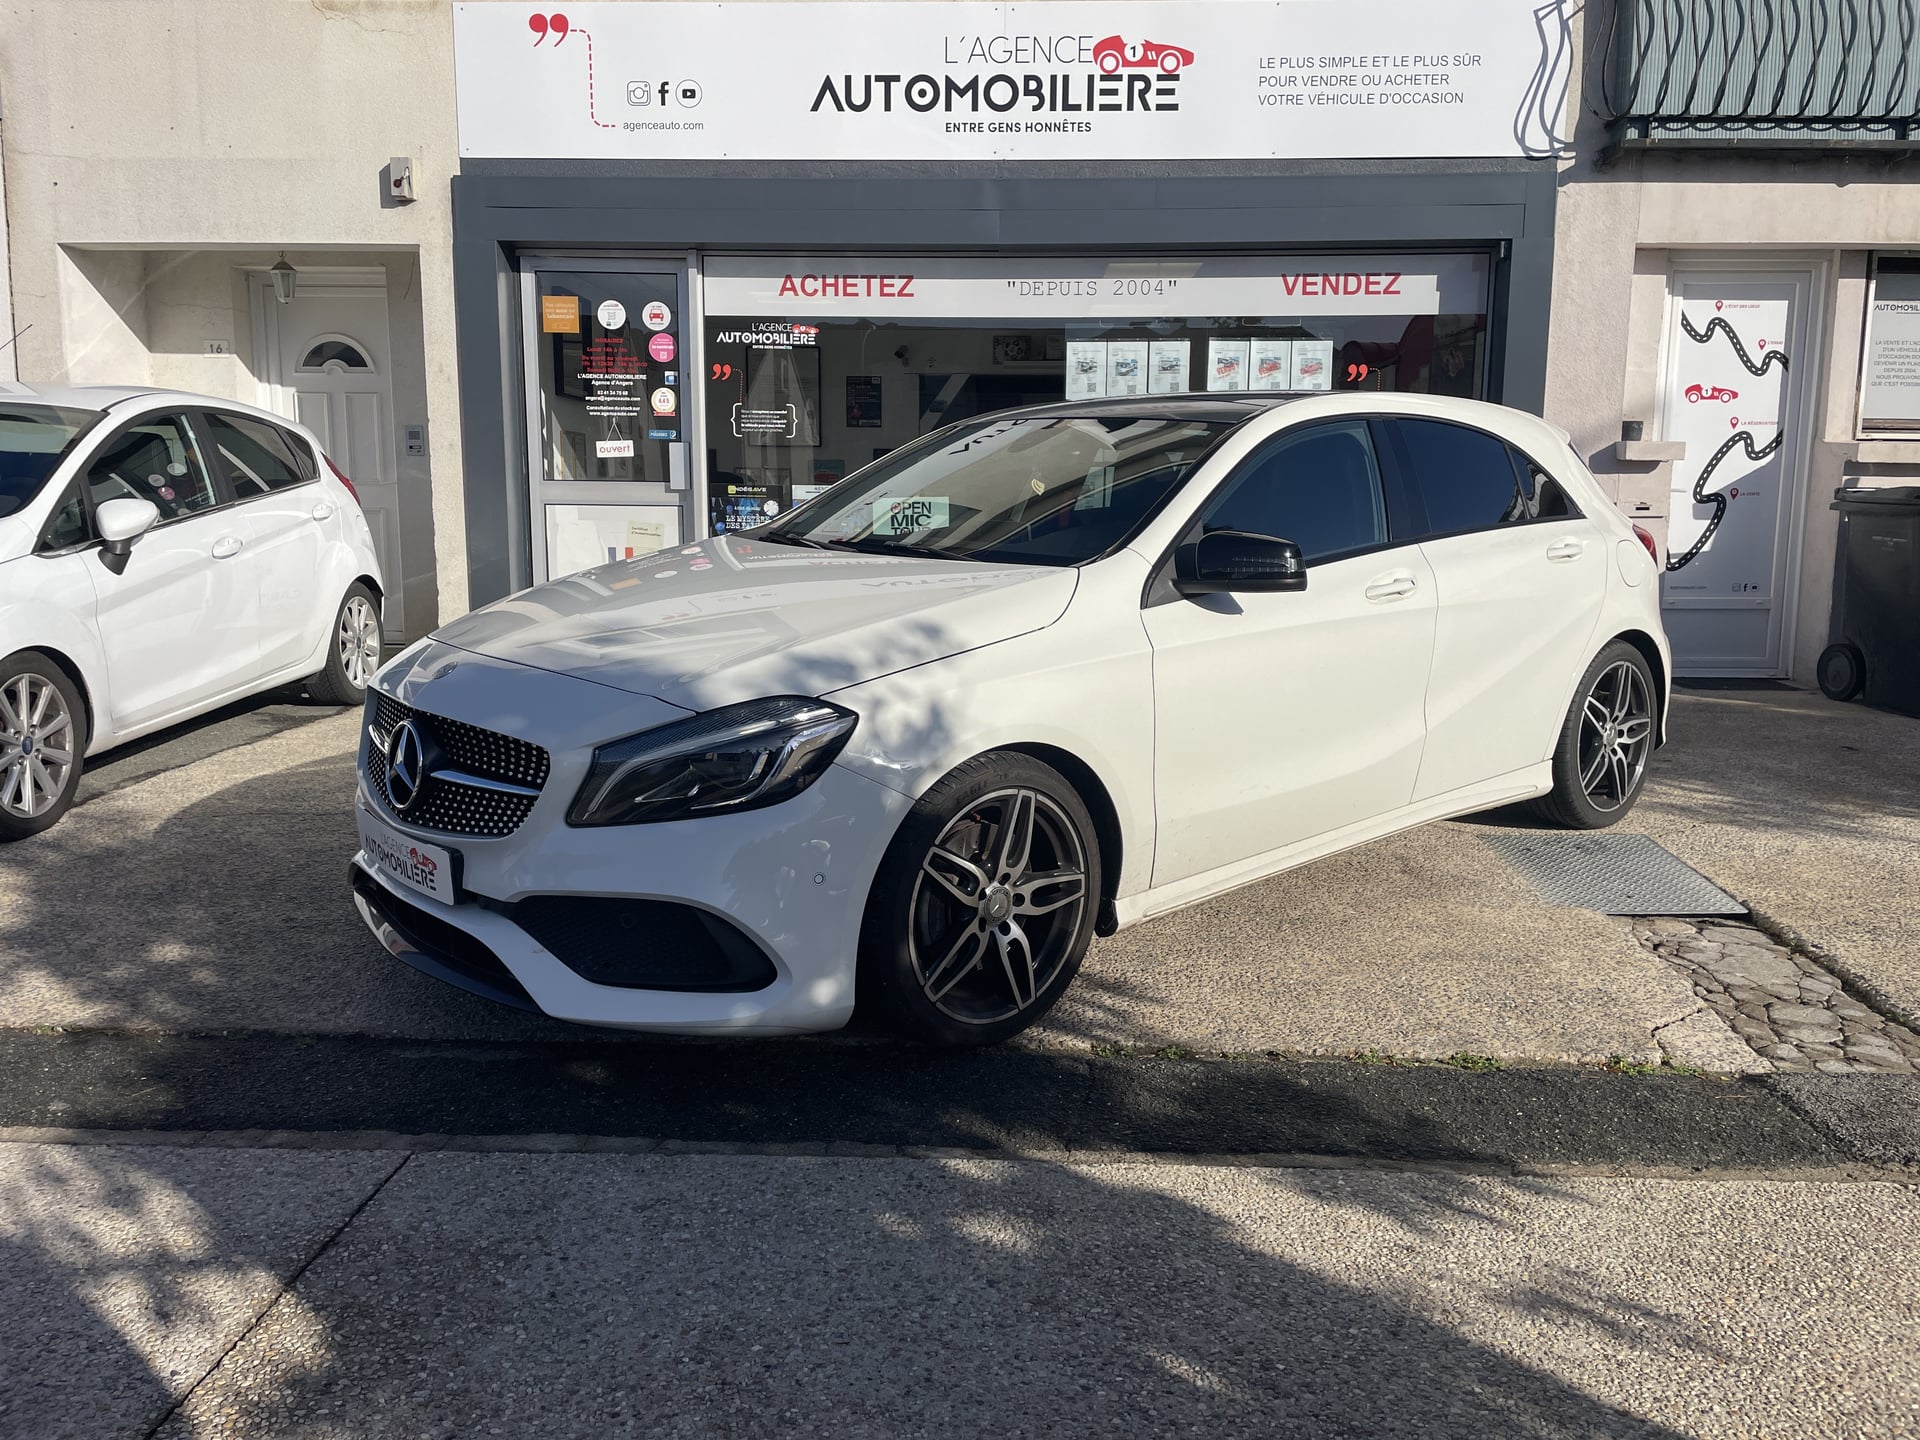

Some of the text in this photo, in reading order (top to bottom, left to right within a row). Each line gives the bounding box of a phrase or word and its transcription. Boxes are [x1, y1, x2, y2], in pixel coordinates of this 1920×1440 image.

[944, 35, 1094, 64] L'AGENCE
[1129, 44, 1137, 58] 1
[1259, 53, 1482, 69] LE PLUS SIMPLE ET LE PLUS SÛR
[1259, 74, 1450, 87] POUR VENDRE OU ACHETER
[1258, 91, 1464, 106] VOTRE VÉHICULE D'OCCASION
[622, 120, 705, 132] agenceauto.com
[945, 118, 1092, 133] ENTRE GENS HONNÊTES
[778, 274, 916, 298] ACHETEZ
[1281, 272, 1401, 296] VENDEZ
[751, 322, 793, 332] L'AGENCE
[209, 343, 223, 354] 16
[599, 444, 630, 454] ouvert
[890, 501, 932, 515] OPEN
[890, 514, 932, 527] MIC
